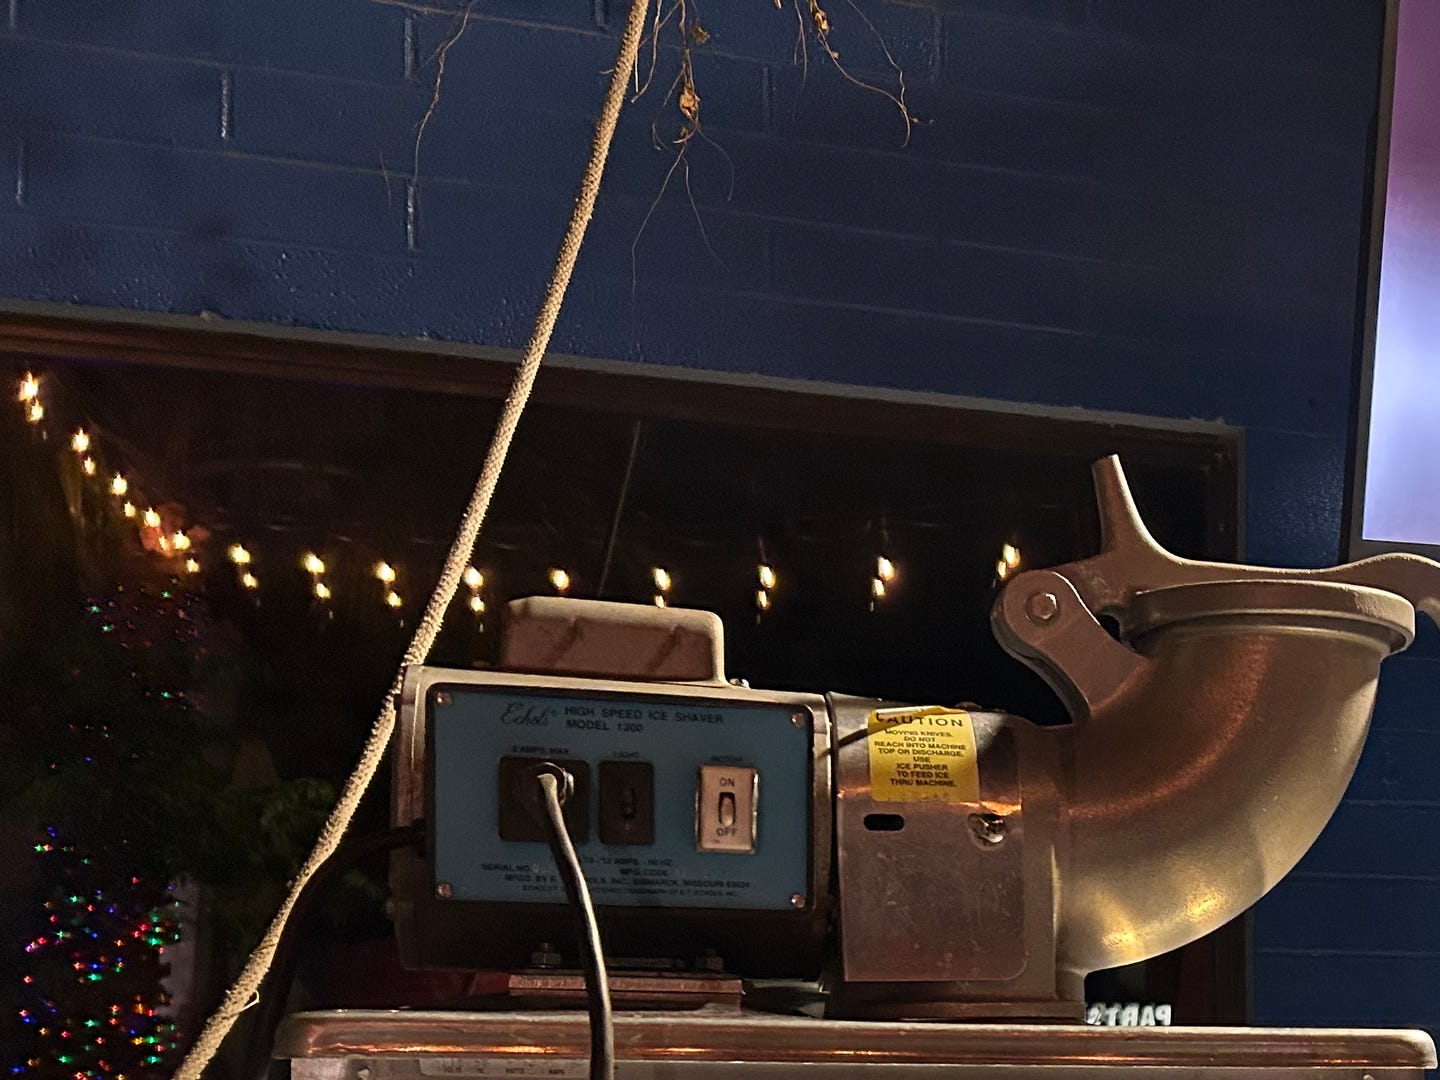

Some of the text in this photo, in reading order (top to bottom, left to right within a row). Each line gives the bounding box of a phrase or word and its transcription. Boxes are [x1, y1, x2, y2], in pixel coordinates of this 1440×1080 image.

[565, 705, 724, 724] HIGH SPEED ICE SHAVER
[566, 718, 610, 731] MODEL
[875, 740, 967, 751] REACH INTO MACHINE
[878, 747, 896, 755] TOP
[896, 762, 949, 771] ICE PUSHER
[896, 770, 950, 779] TO FEED ICE
[719, 776, 736, 787] ON
[890, 778, 914, 786] THRU
[715, 826, 737, 838] OFF
